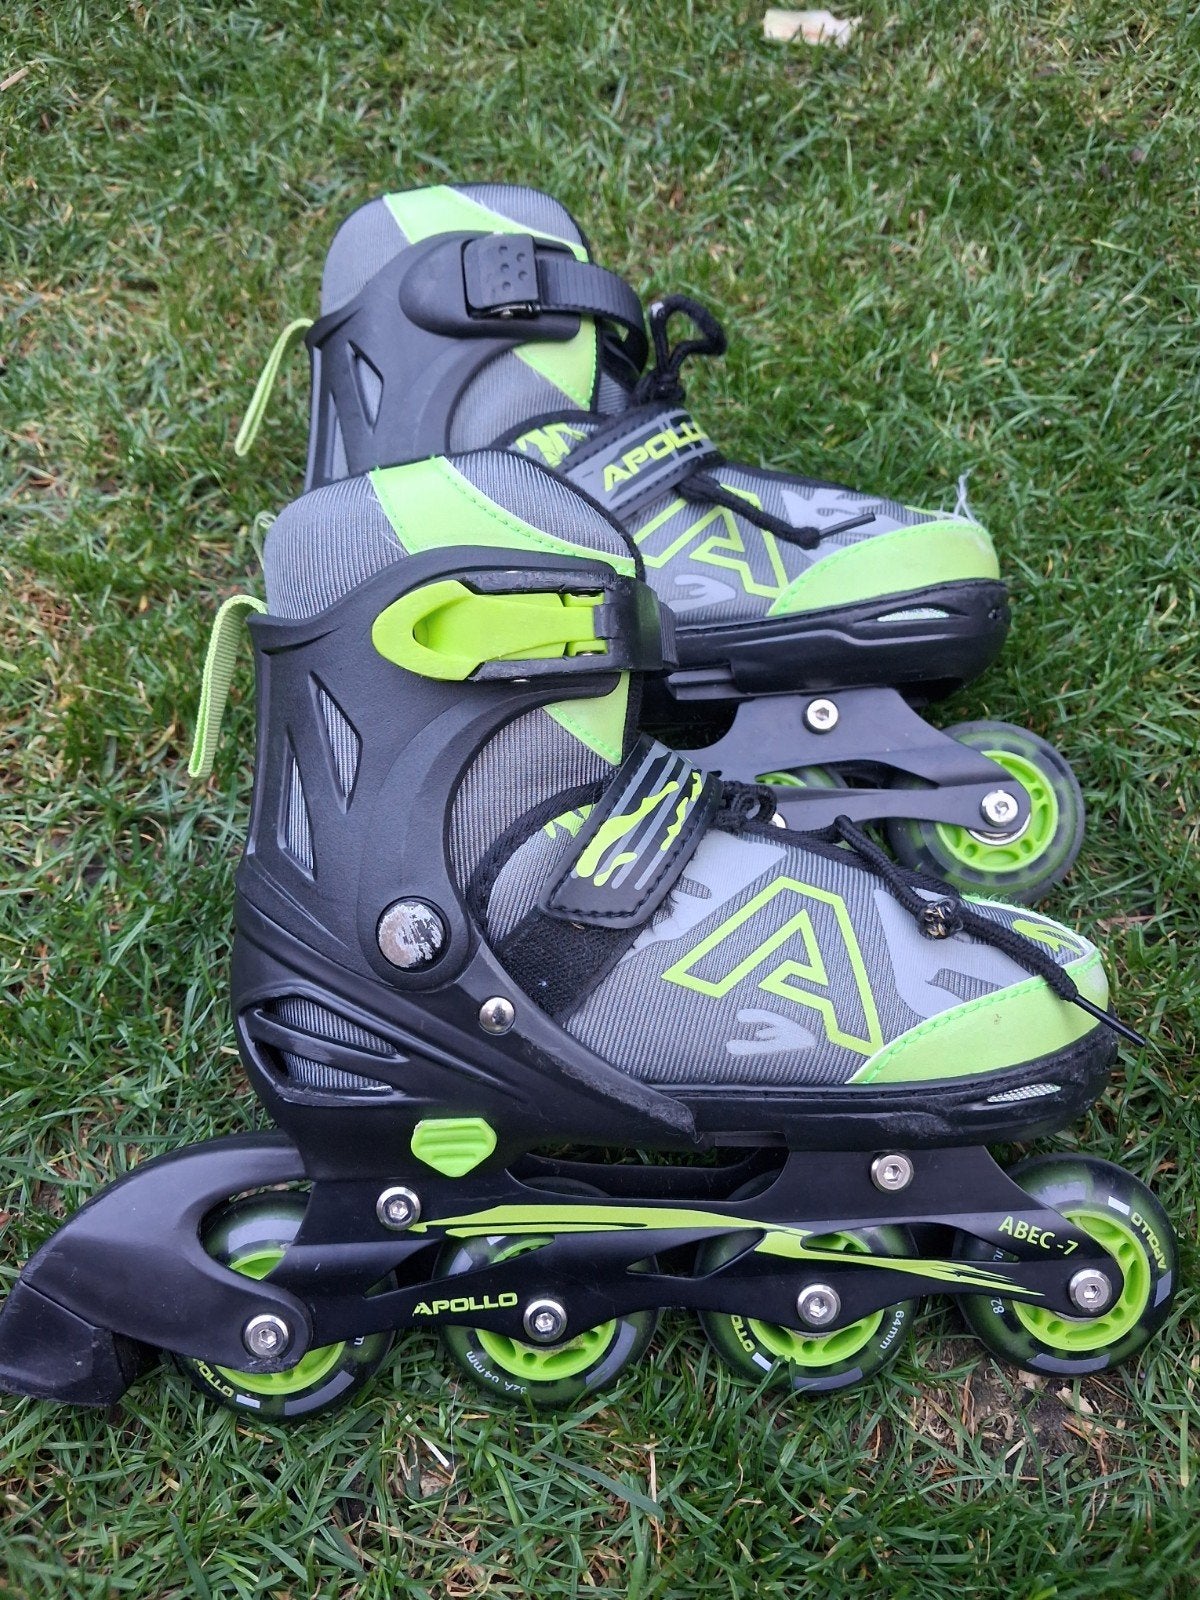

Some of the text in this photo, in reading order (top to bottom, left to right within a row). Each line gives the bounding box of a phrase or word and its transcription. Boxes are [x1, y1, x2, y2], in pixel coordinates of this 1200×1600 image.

[998, 1215, 1056, 1249] ABEC
[1130, 1212, 1167, 1269] APOLLO
[412, 1292, 518, 1317] APOLLO
[990, 1297, 1005, 1314] 82
[730, 1314, 755, 1353] OLLO
[880, 1310, 905, 1349] 64mm
[193, 1358, 234, 1398] POLLO
